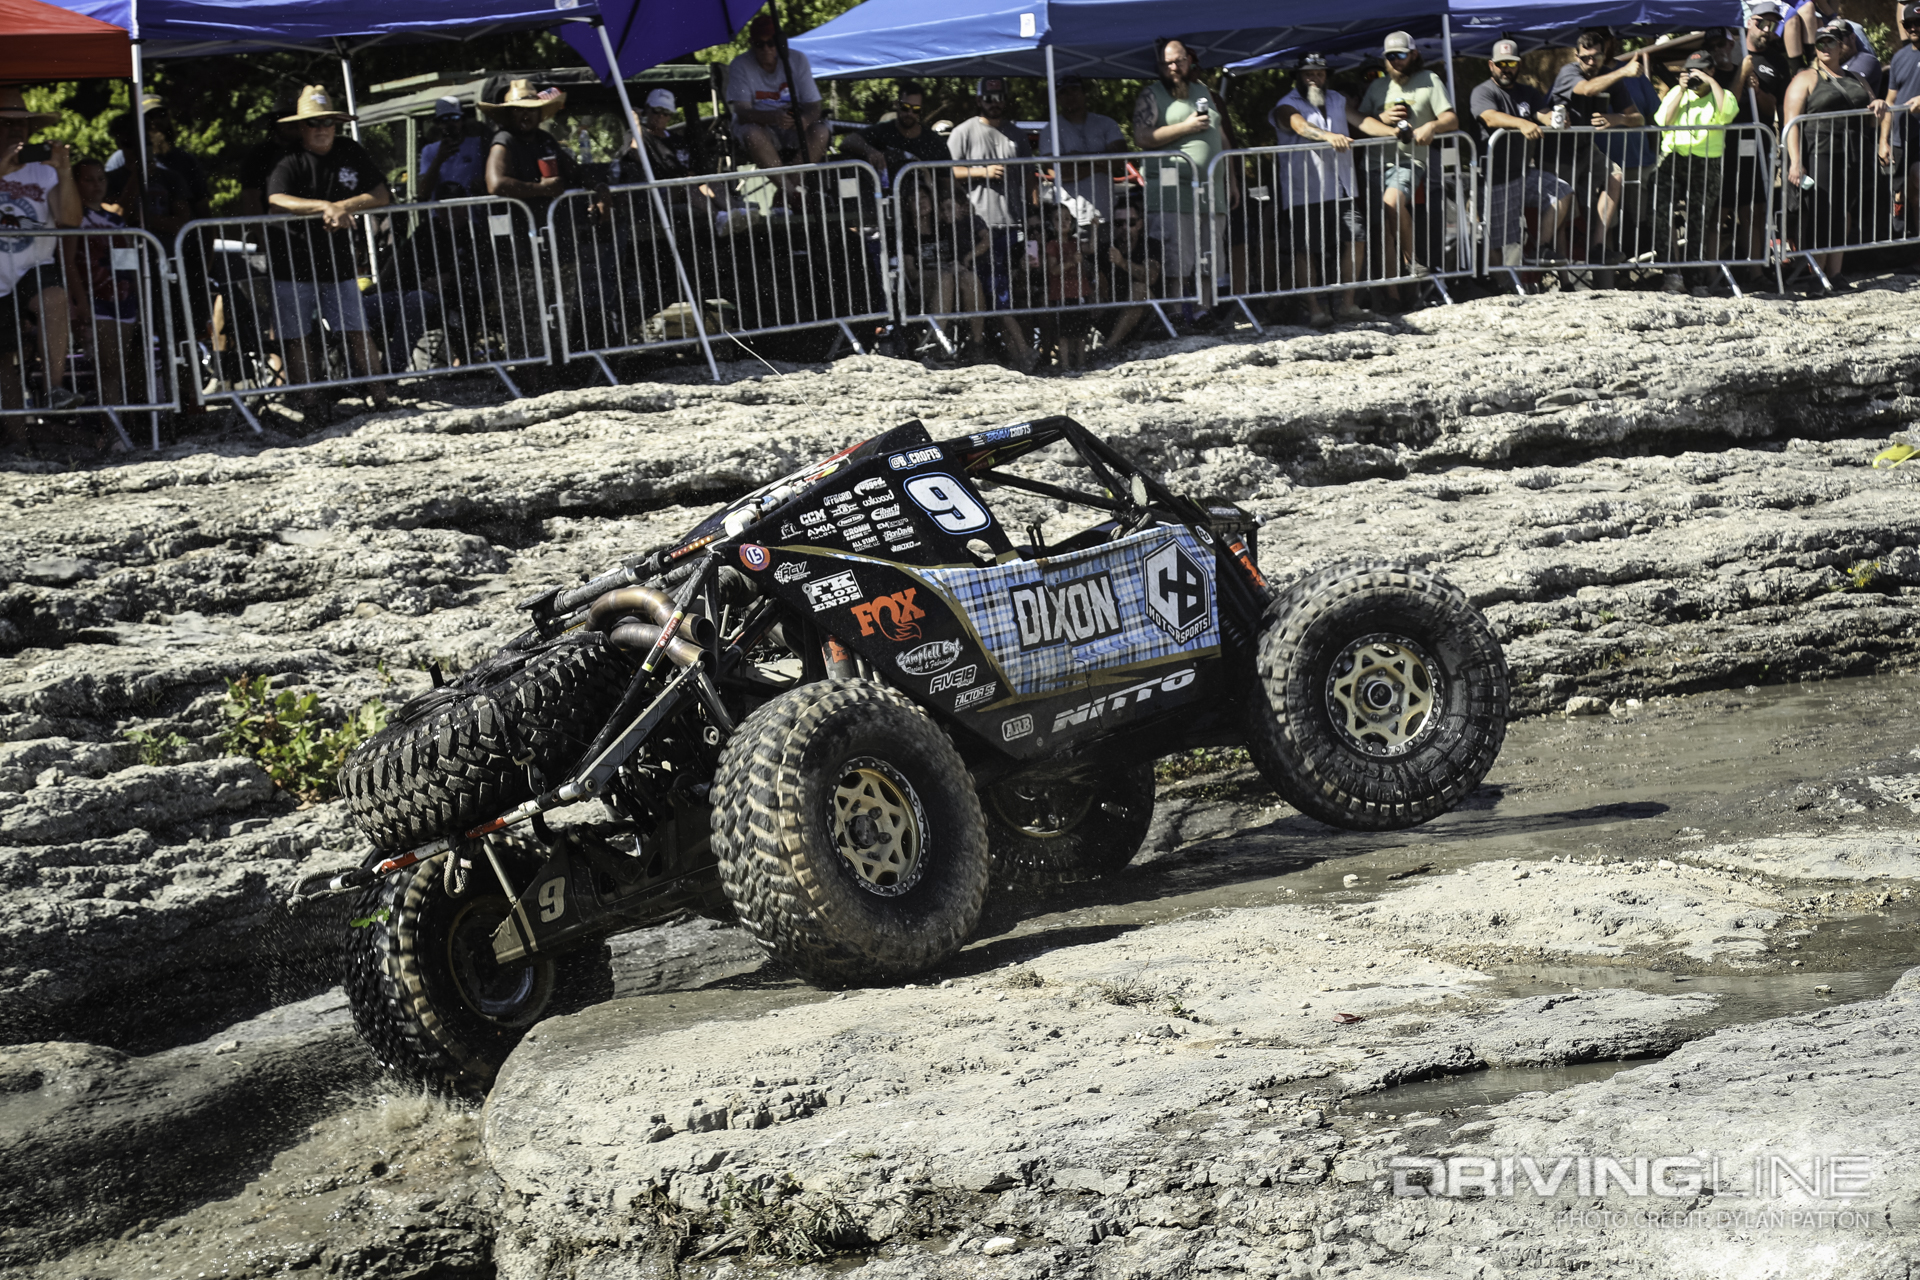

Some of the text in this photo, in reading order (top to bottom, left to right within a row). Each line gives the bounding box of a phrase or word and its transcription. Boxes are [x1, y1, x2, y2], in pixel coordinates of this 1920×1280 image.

[1009, 424, 1032, 438] CROFTS
[890, 447, 942, 469] @B_CROFTS
[871, 503, 900, 520] Eibach
[906, 474, 988, 533] 9
[799, 508, 827, 526] CCM
[807, 523, 836, 537] AXIA
[842, 522, 871, 537] CROMM
[852, 541, 862, 549] ALL
[861, 535, 878, 546] START
[747, 548, 763, 563] 15
[812, 572, 856, 598] FK
[819, 585, 859, 601] ROD
[812, 591, 862, 613] ENDS
[850, 587, 926, 639] FOX
[1012, 576, 1120, 647] DIXON
[1148, 605, 1209, 644] MOTORSPORTS
[895, 643, 941, 668] Campbell
[955, 684, 996, 706] FACTOR 55
[1051, 668, 1196, 734] NITTO
[1005, 716, 1032, 738] ARB
[538, 876, 566, 923] 9
